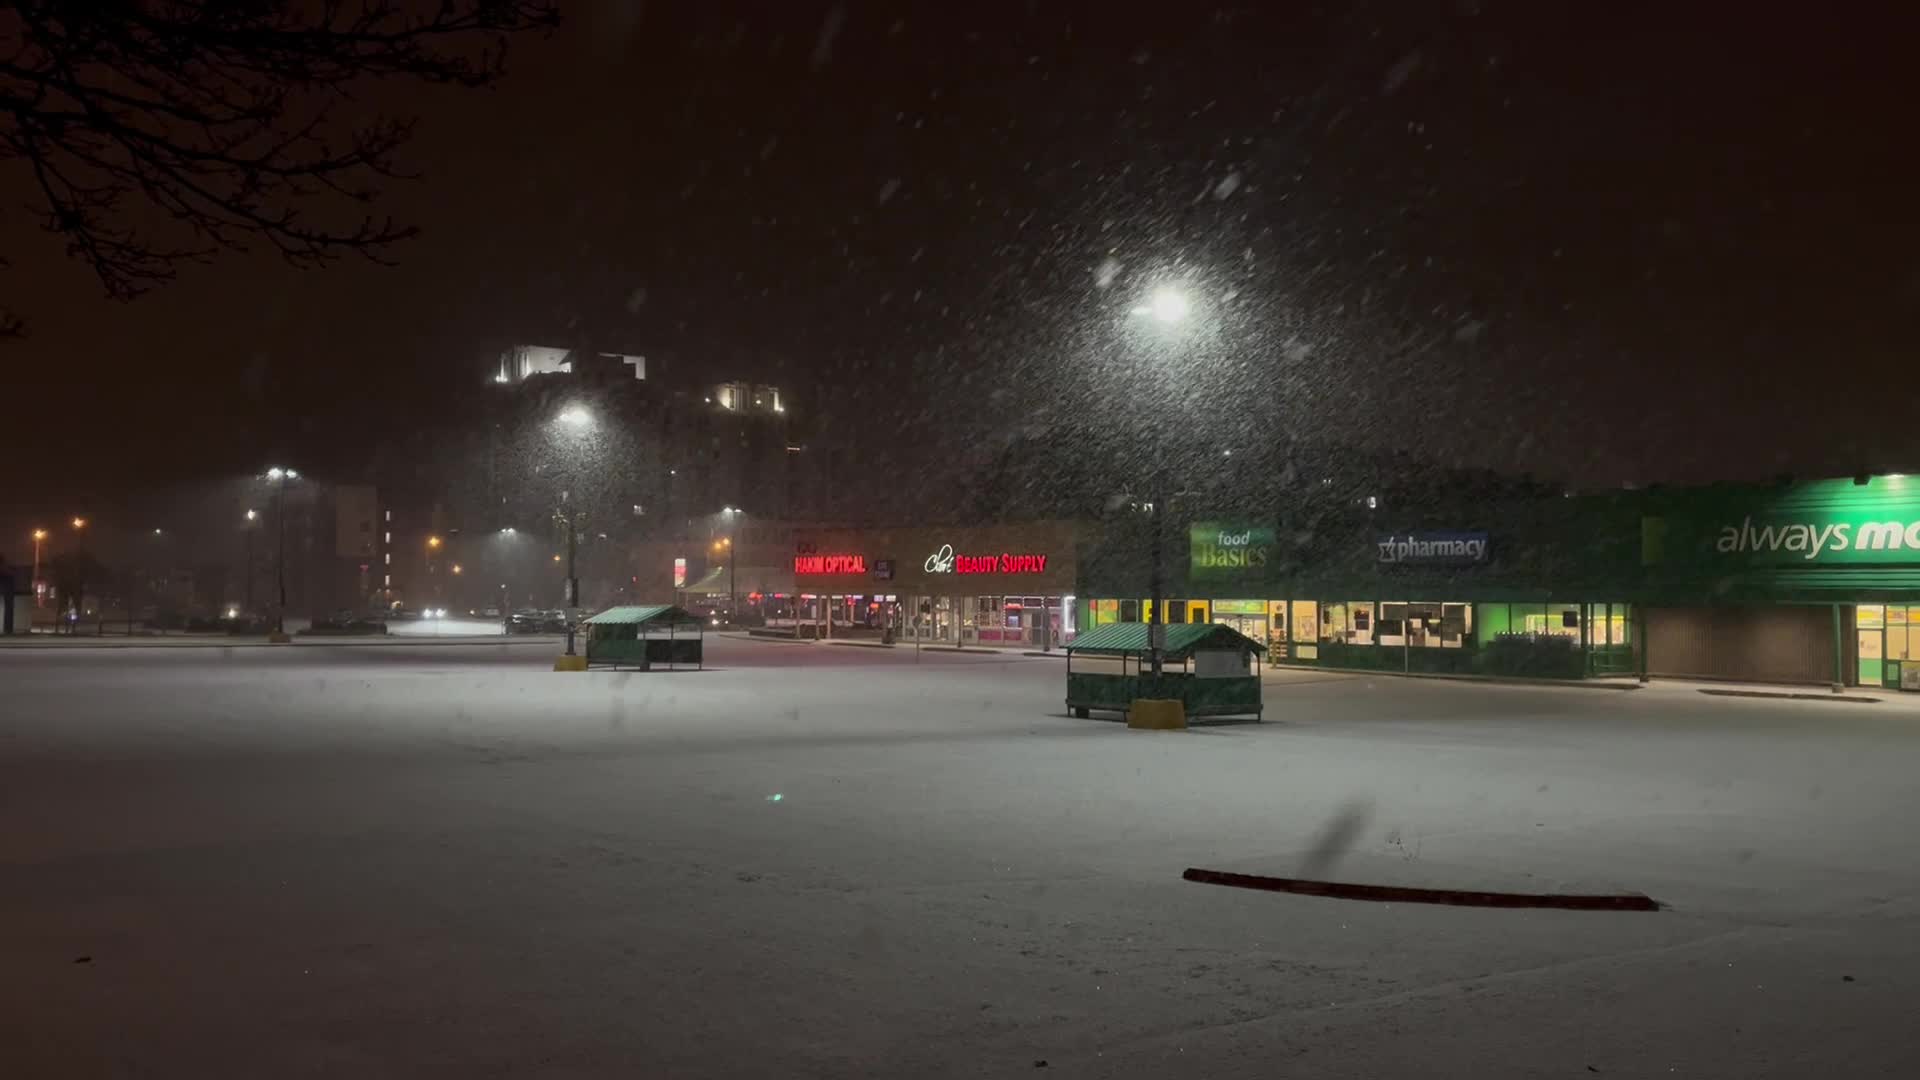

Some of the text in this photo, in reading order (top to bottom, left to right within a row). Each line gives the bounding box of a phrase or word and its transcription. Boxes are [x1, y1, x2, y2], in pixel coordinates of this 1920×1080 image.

[1218, 530, 1250, 545] food
[1716, 514, 1851, 560] always
[1201, 545, 1266, 567] Basics
[1397, 536, 1486, 562] pharmacy
[795, 555, 824, 573] HAKIM
[825, 555, 866, 573] OPTICAL
[956, 554, 999, 574] BEAUTY
[1001, 553, 1046, 573] SUPPLY
